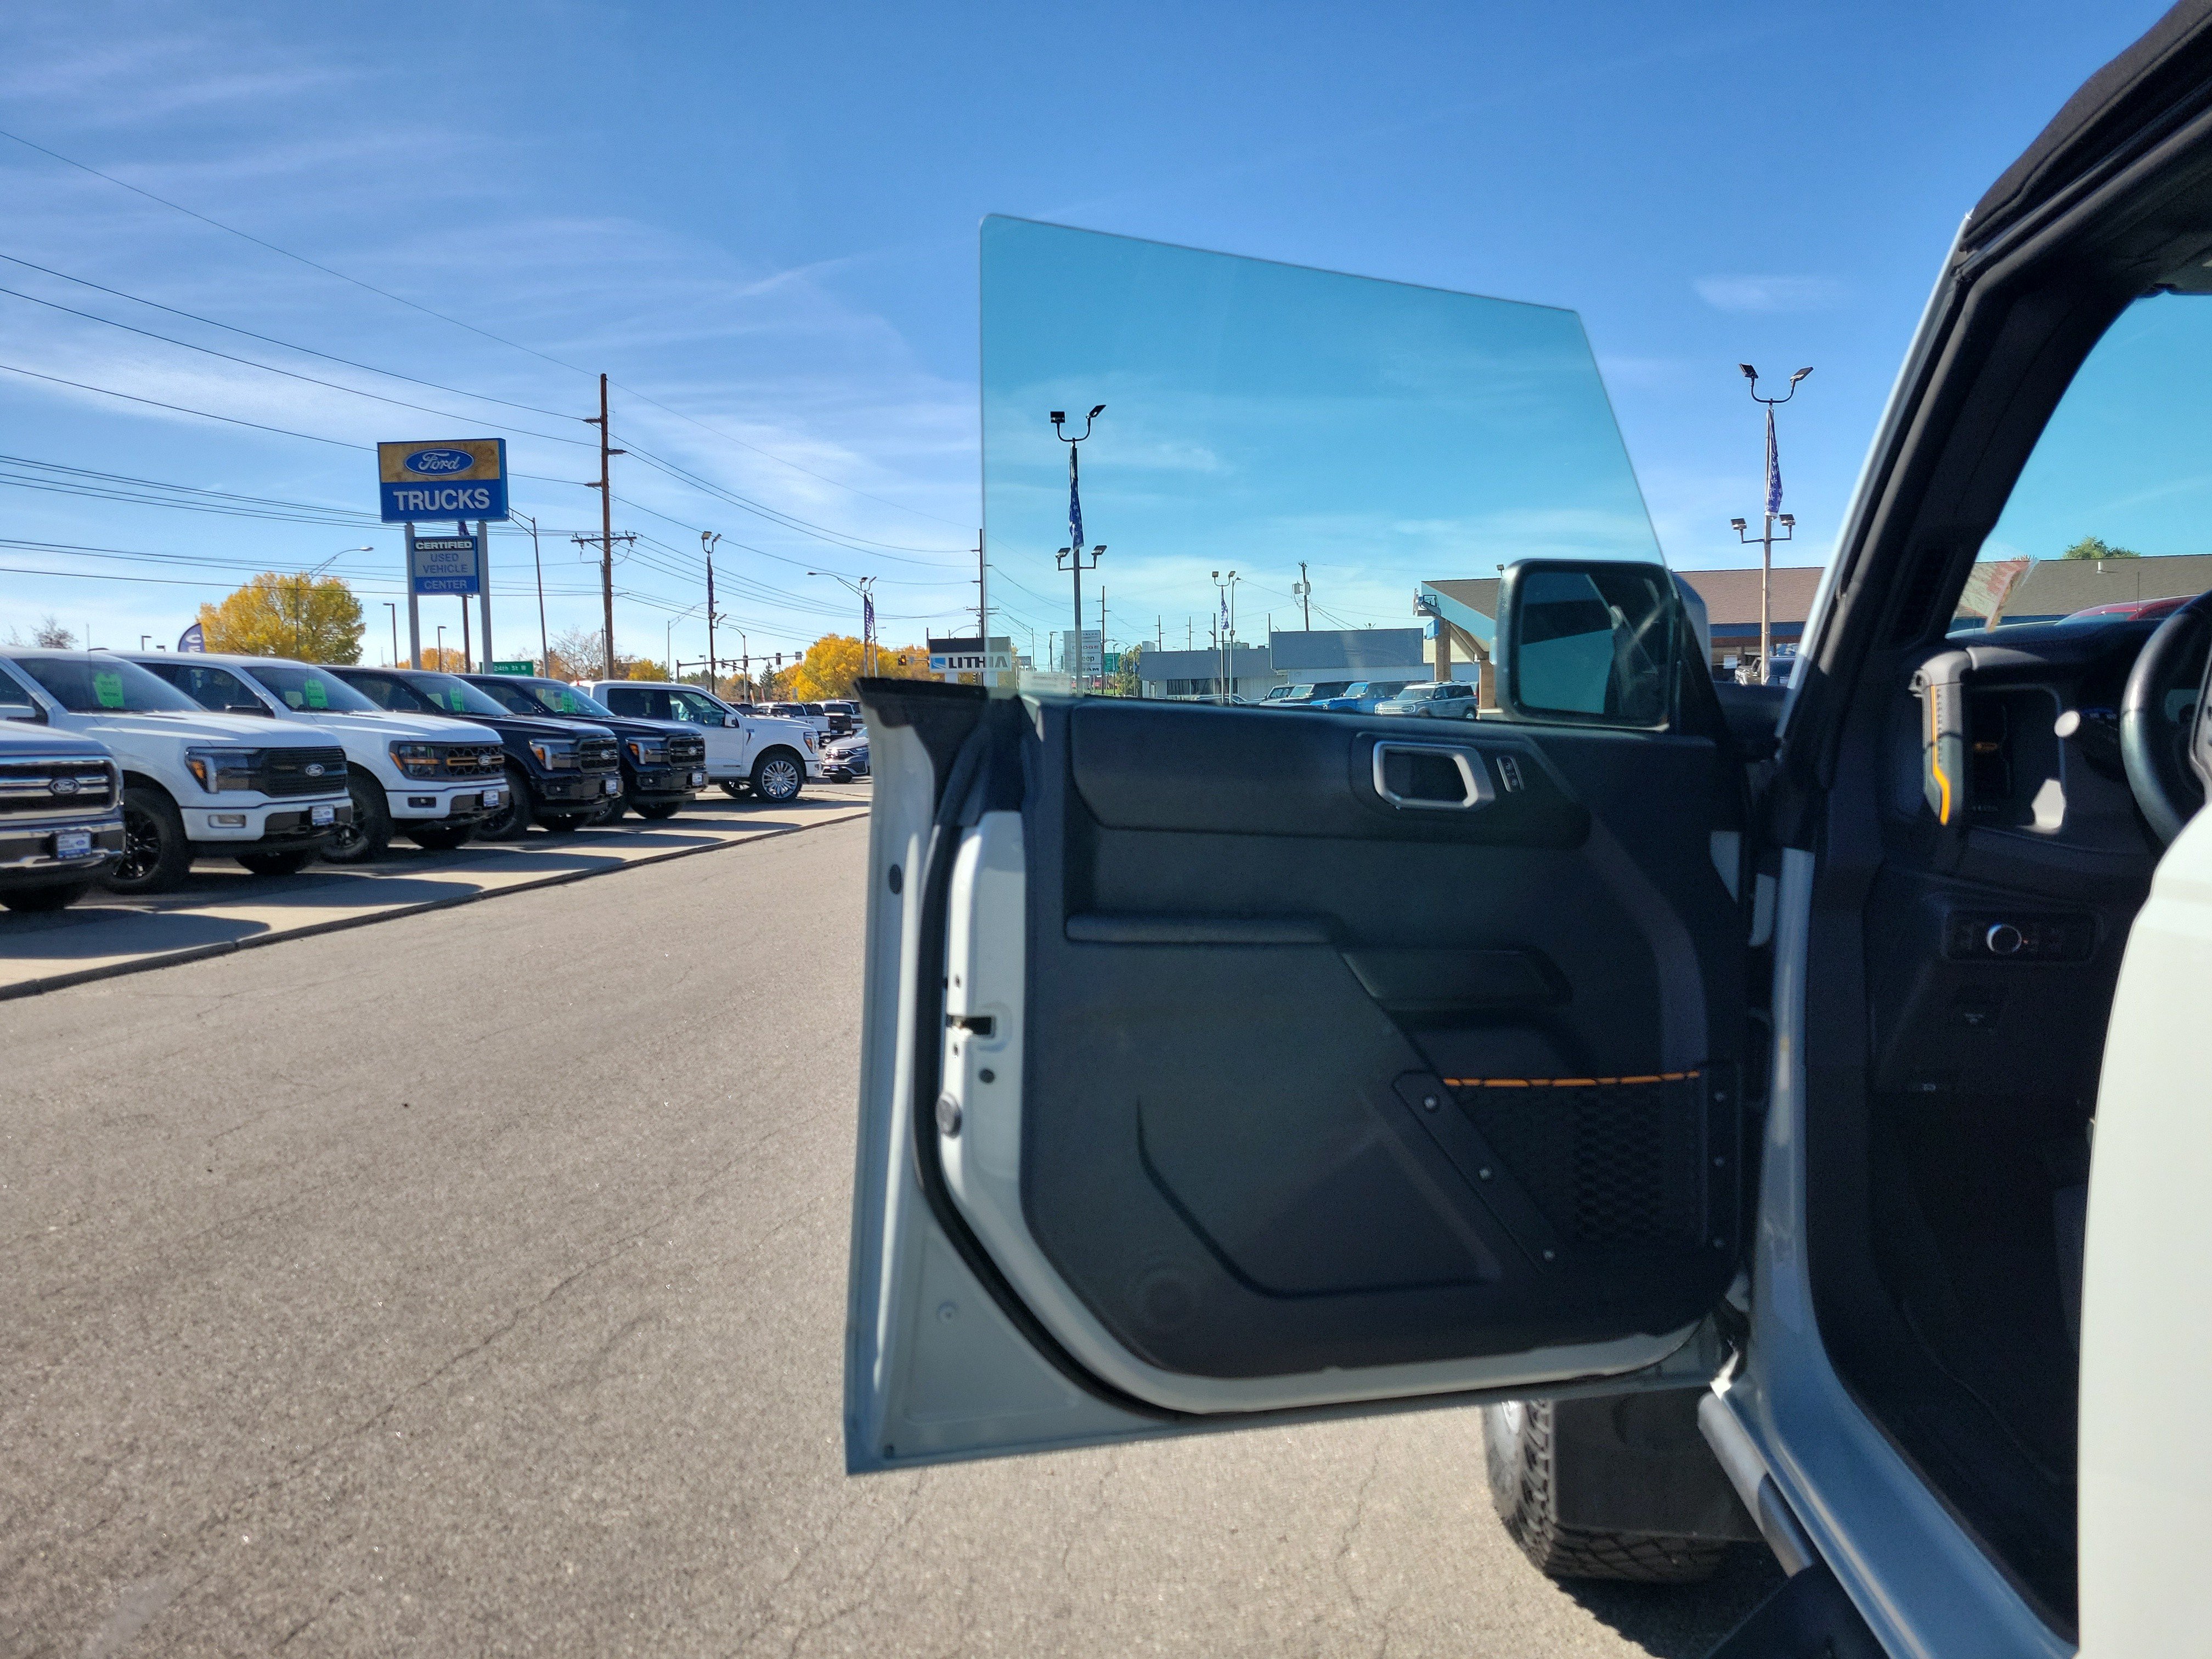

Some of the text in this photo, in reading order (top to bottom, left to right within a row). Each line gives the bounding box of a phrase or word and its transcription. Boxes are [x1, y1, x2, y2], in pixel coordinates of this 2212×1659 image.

[417, 452, 460, 471] Ford
[393, 488, 491, 511] TRUCKS
[415, 540, 473, 550] CERTIFIED
[430, 553, 459, 562] USED
[422, 563, 469, 574] VEHICLE
[424, 580, 467, 590] CENTER
[948, 656, 1008, 669] LITHIA
